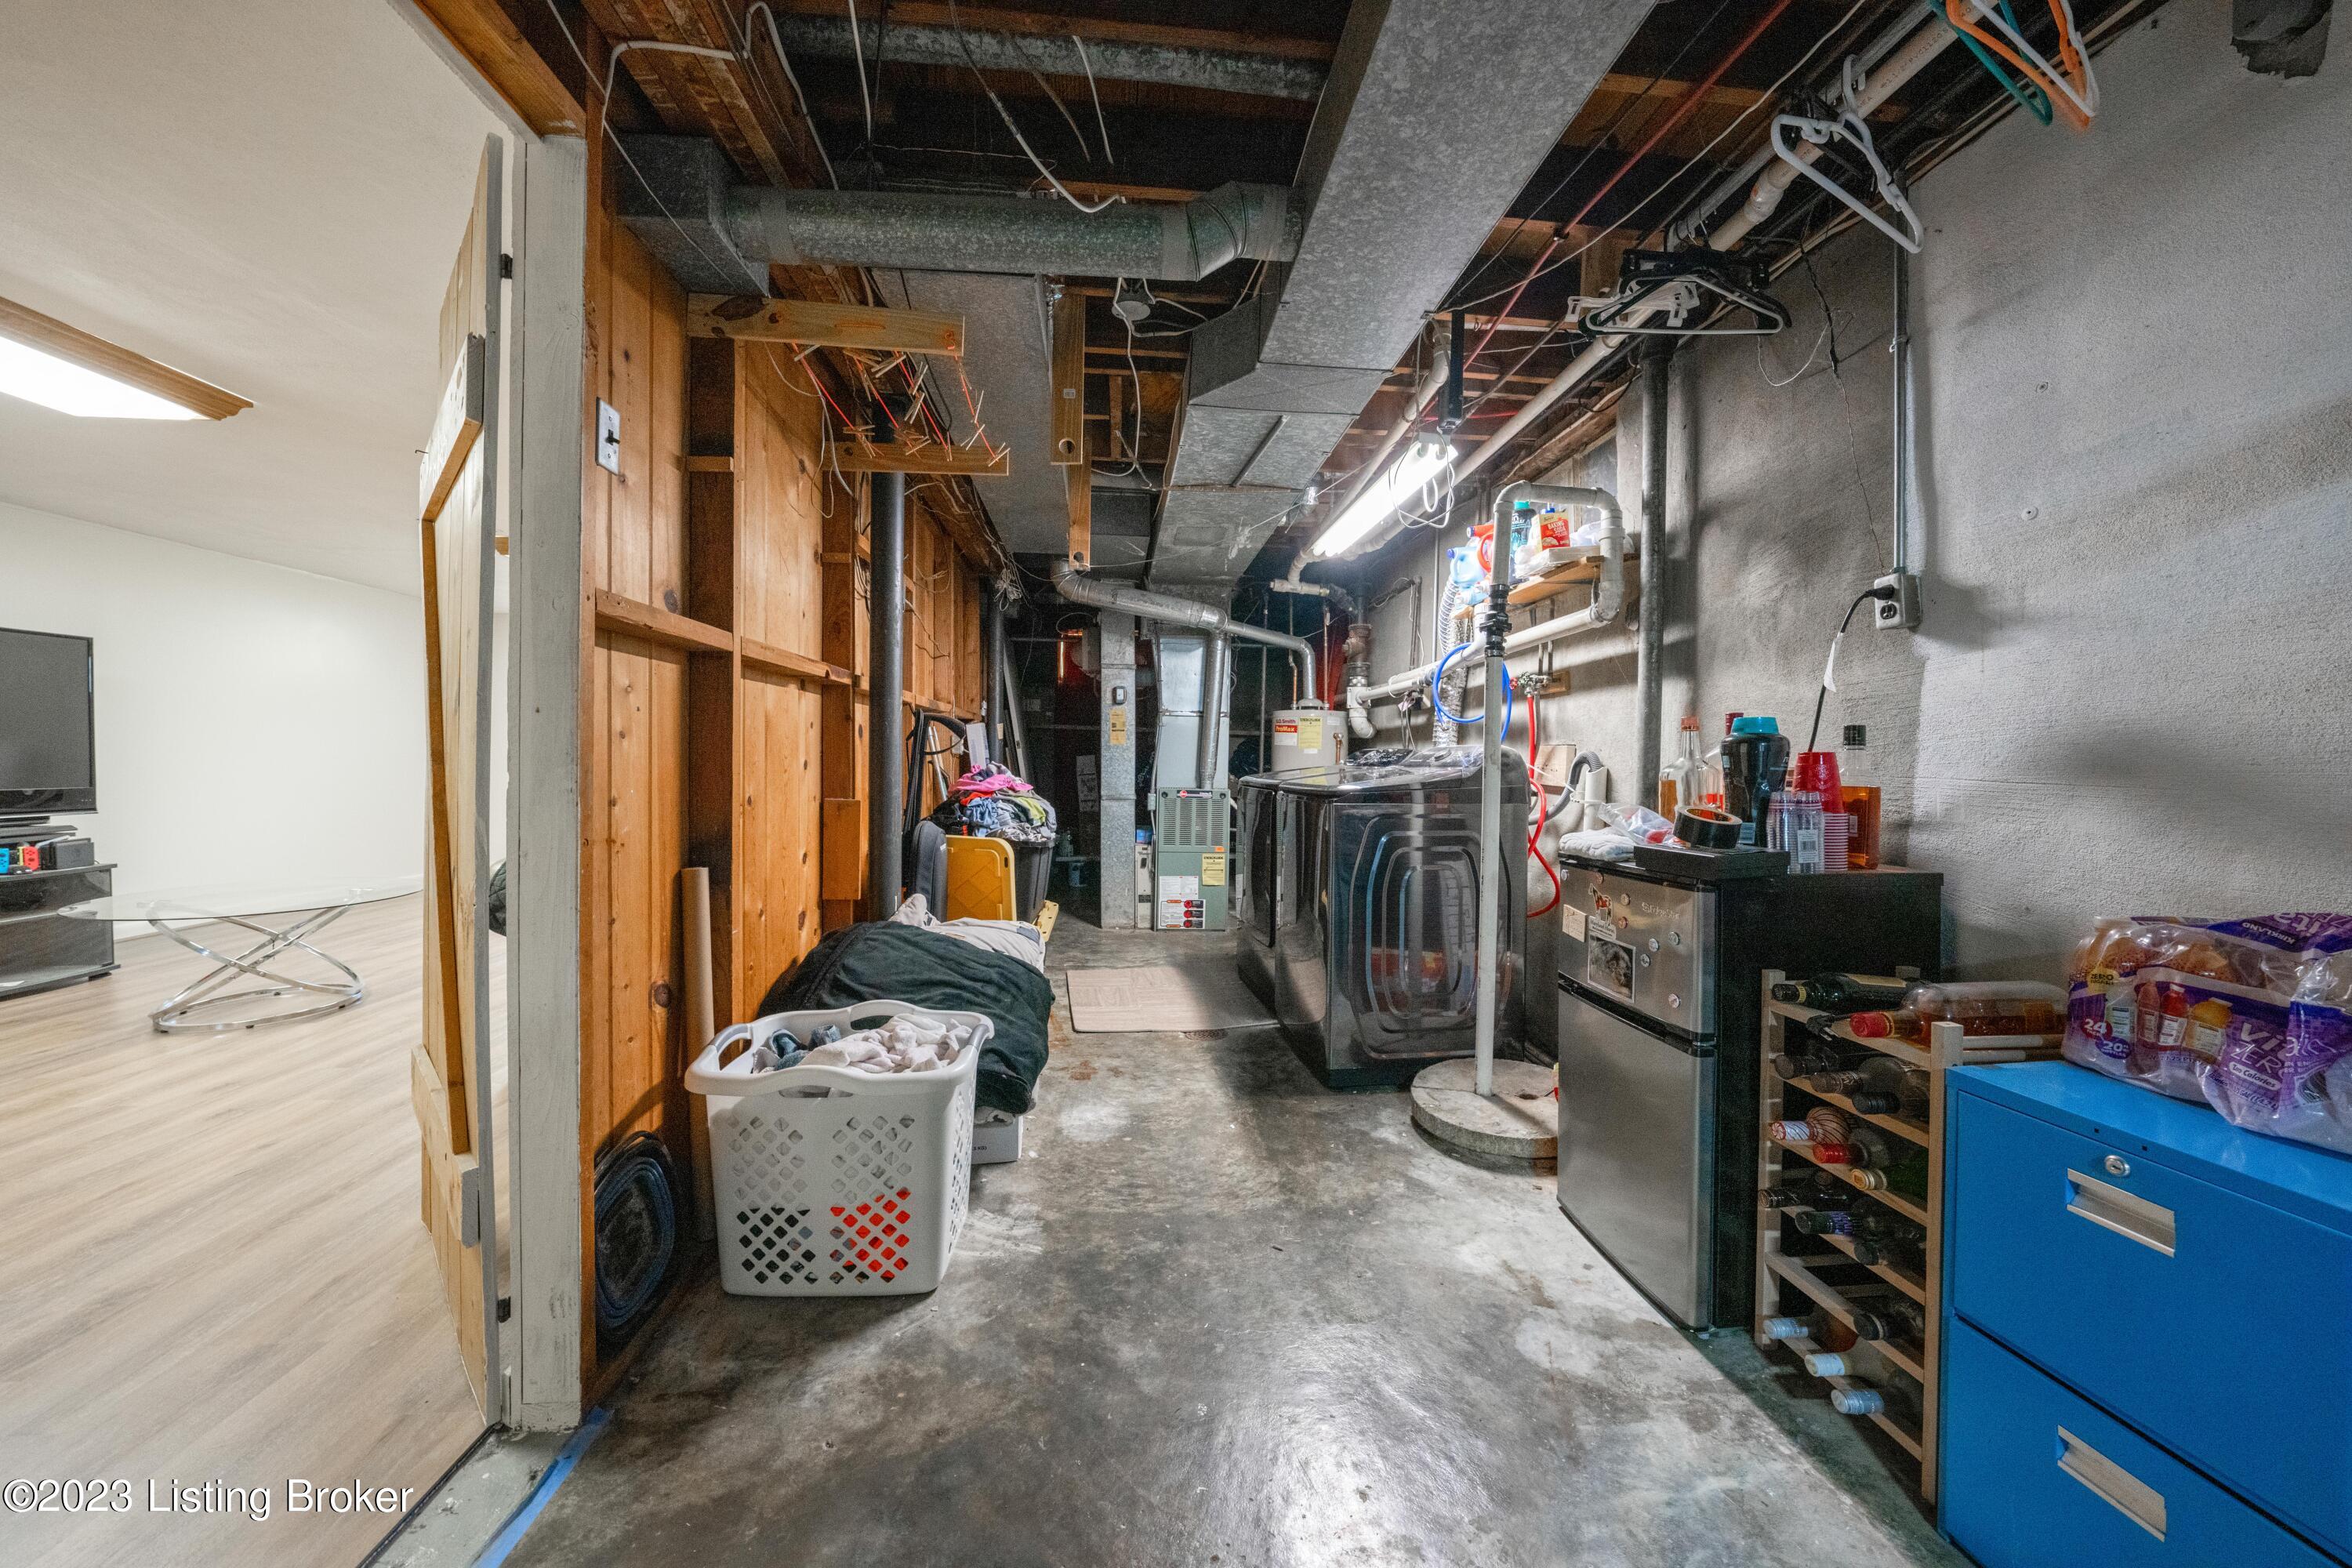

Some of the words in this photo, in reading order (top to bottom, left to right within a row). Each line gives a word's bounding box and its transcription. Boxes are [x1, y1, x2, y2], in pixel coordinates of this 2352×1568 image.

[1548, 520, 1564, 529] BAKING
[2241, 922, 2296, 944] KIRKLAND
[2084, 1018, 2107, 1034] 24
[2103, 1041, 2123, 1052] 20
[2243, 1069, 2276, 1088] Calories
